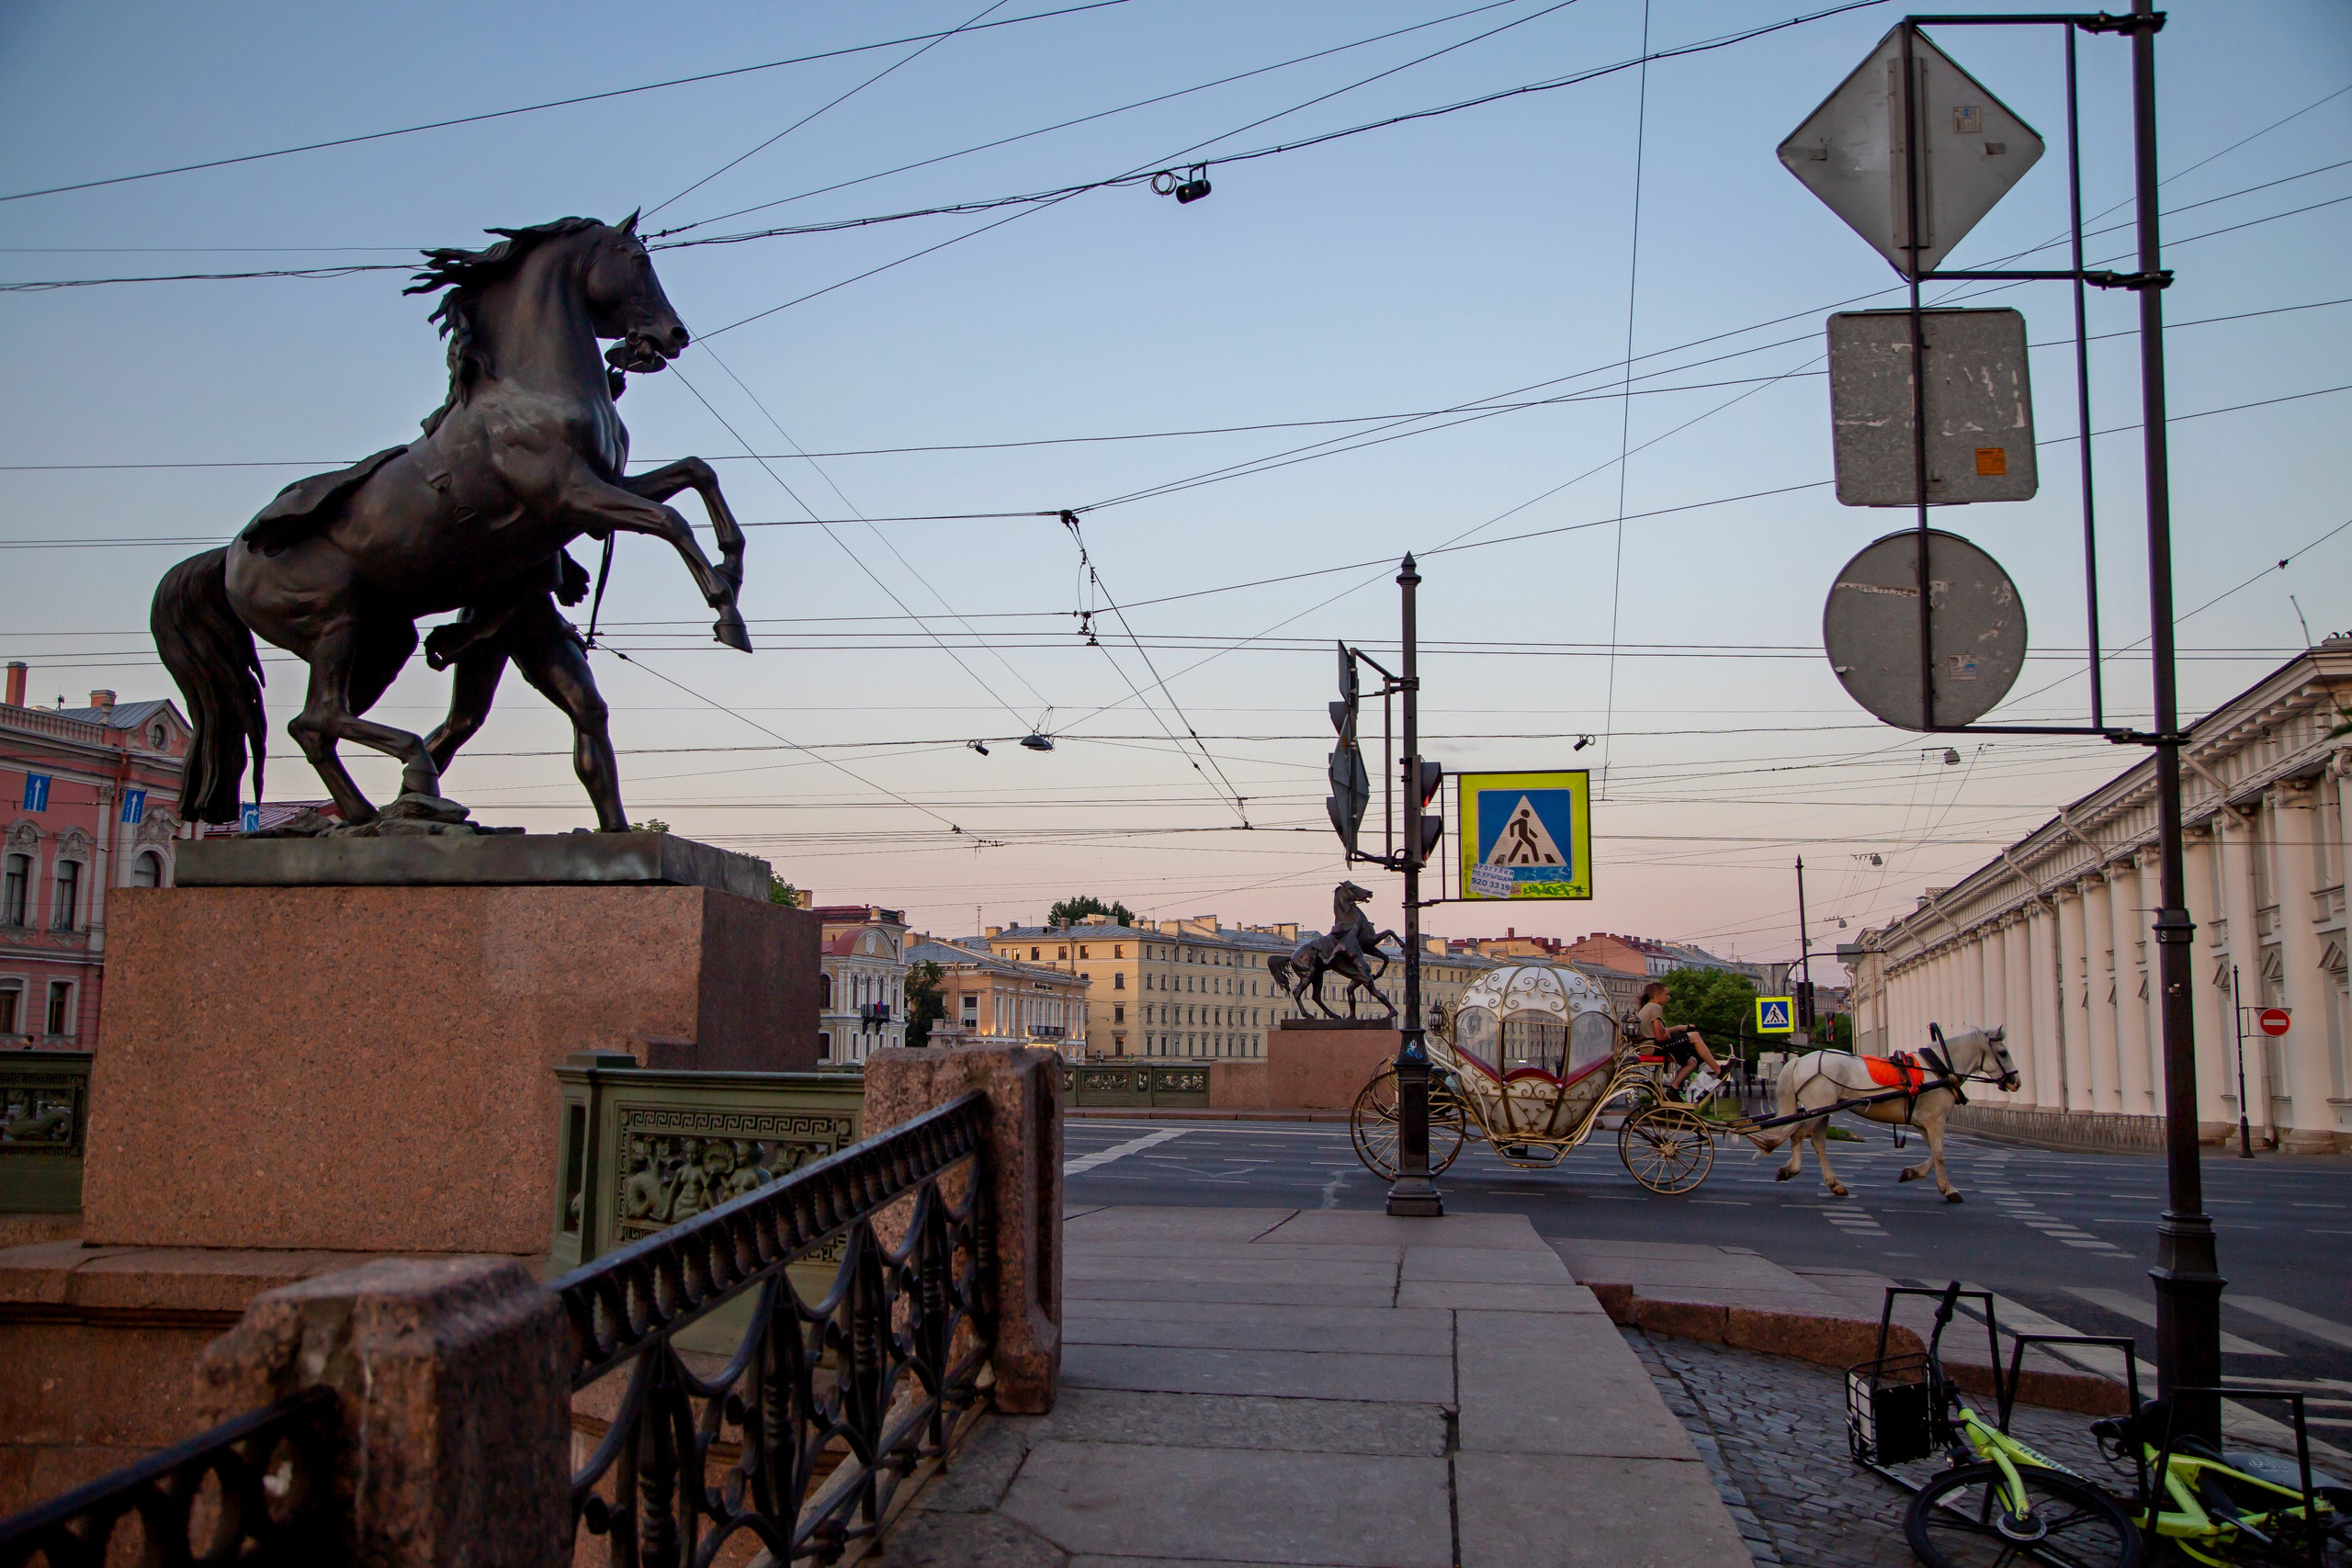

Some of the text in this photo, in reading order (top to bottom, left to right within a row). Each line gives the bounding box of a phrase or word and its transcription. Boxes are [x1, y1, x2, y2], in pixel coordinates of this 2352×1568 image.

[1474, 863, 1514, 876] ПРОГУЛКИ
[1471, 877, 1488, 886] 920
[1488, 881, 1499, 889] 33
[1482, 872, 1514, 882] КРЫШАМ
